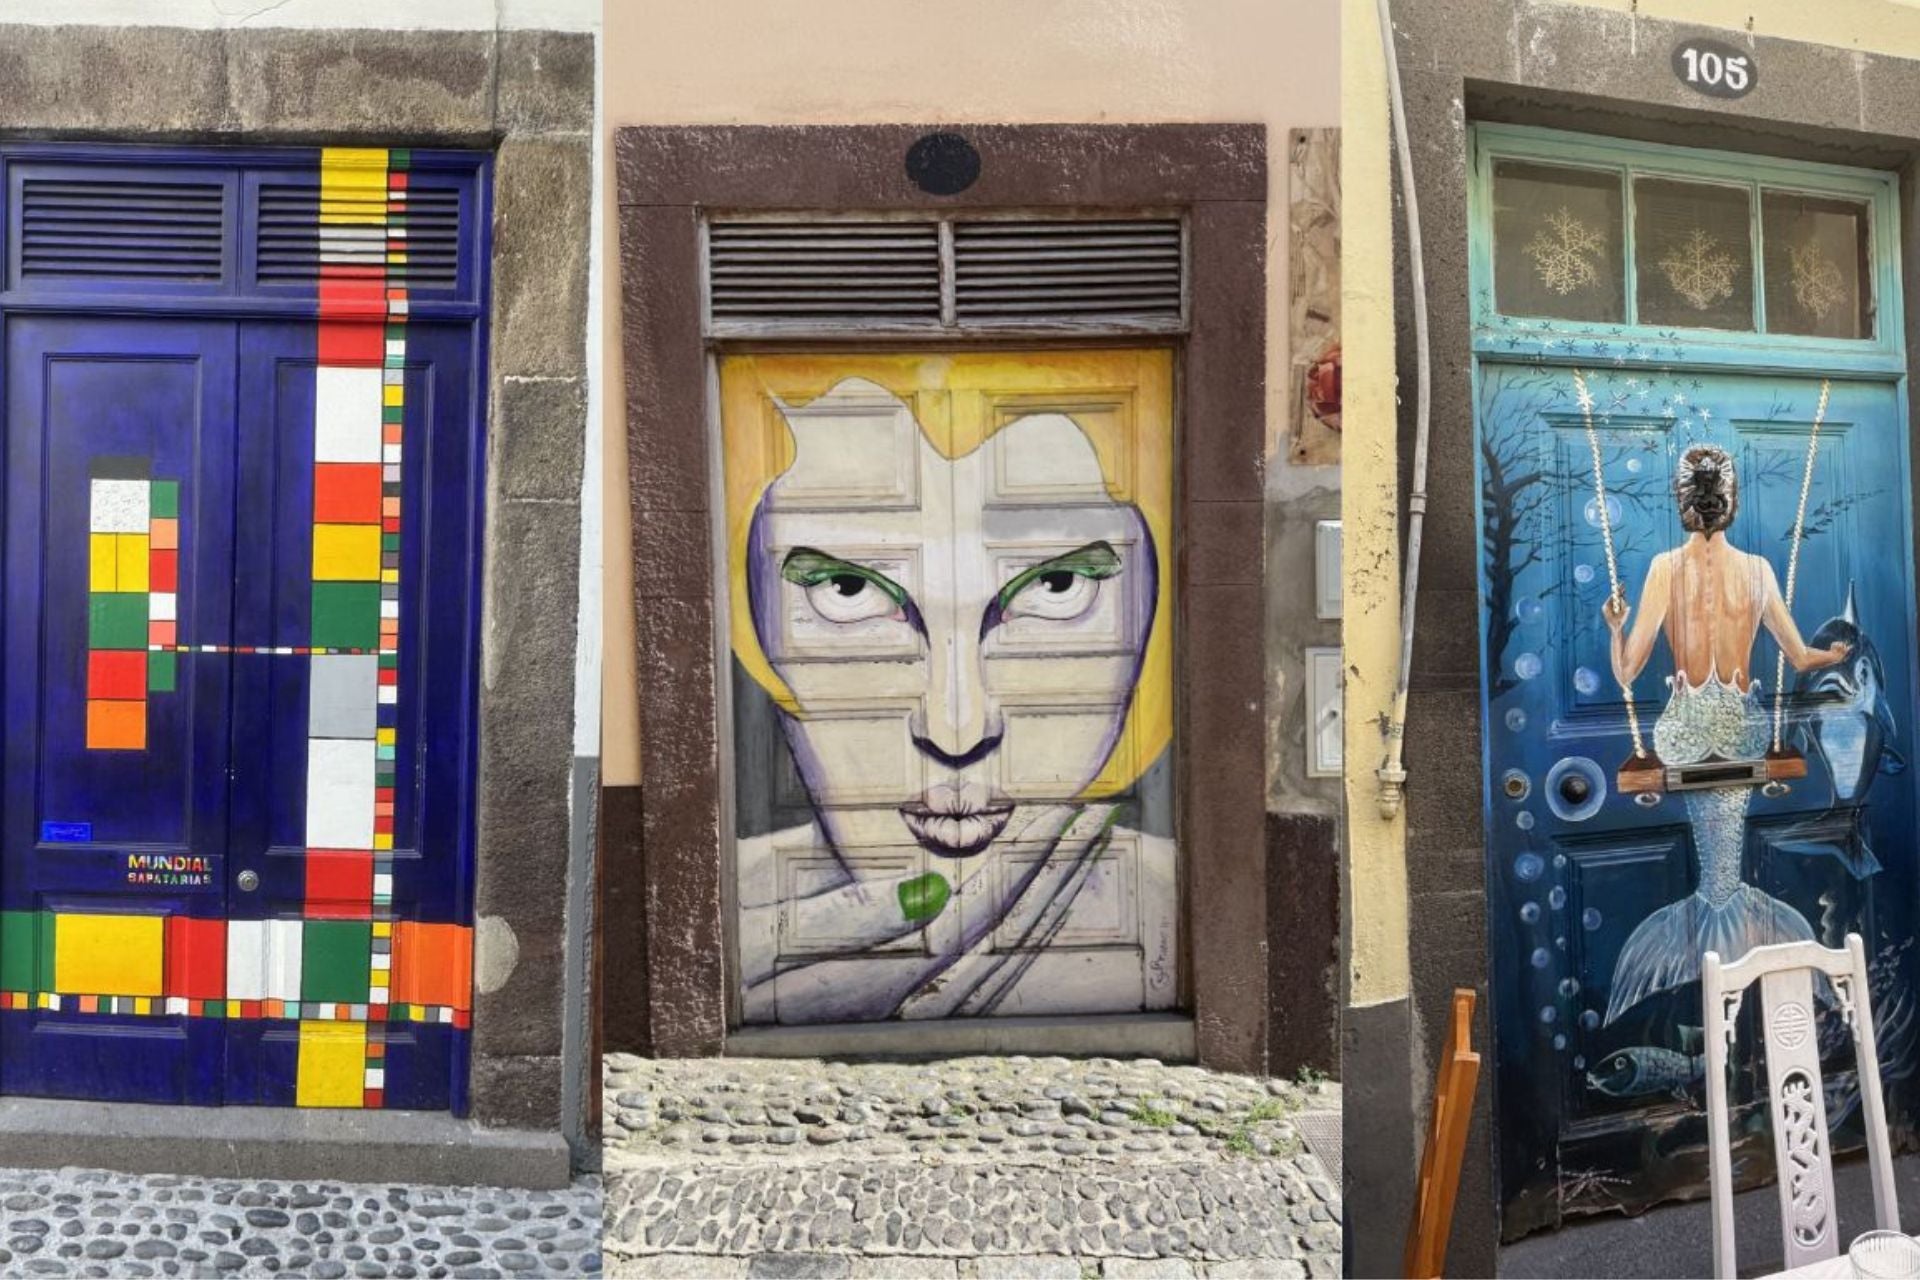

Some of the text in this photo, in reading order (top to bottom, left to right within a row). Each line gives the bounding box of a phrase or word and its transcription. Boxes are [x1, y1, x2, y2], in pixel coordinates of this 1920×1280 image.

[1681, 48, 1749, 90] 105
[128, 854, 212, 872] MUNDIAL
[128, 872, 212, 885] SAPATARIAS
